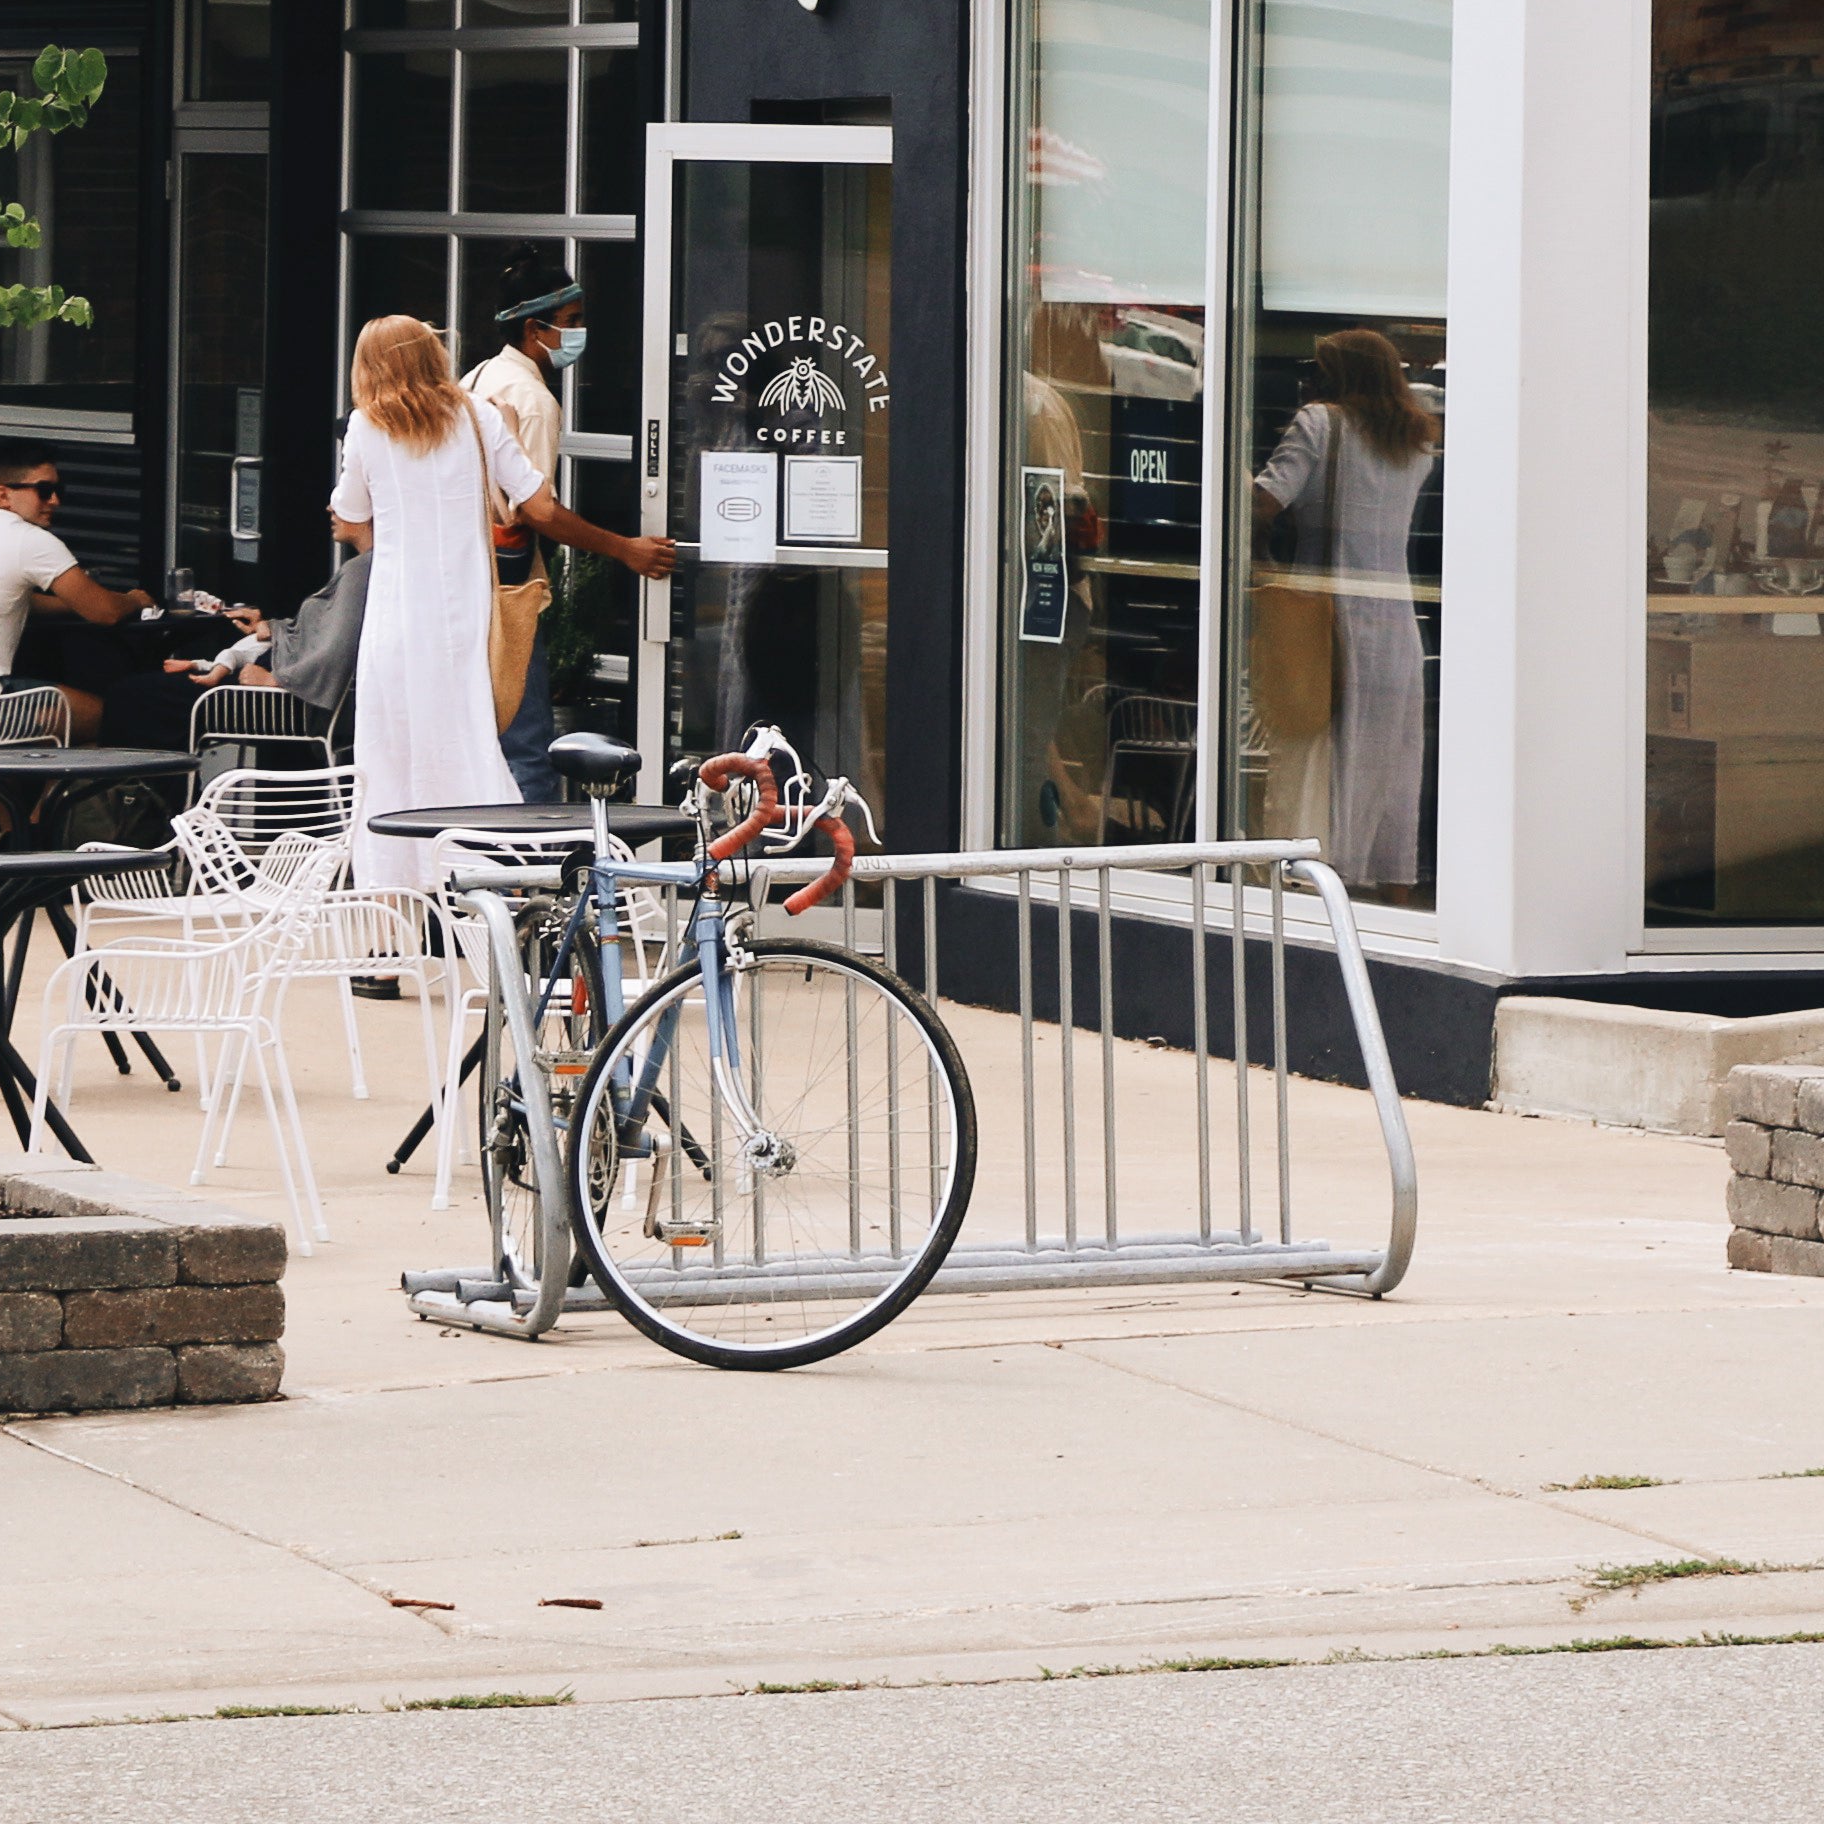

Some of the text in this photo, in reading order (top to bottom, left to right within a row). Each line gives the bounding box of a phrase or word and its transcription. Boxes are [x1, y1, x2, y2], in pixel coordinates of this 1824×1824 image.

[710, 315, 890, 413] WONDERSTATE
[650, 422, 658, 457] PULL
[756, 427, 846, 445] COFFEE
[1130, 449, 1168, 484] OPEN
